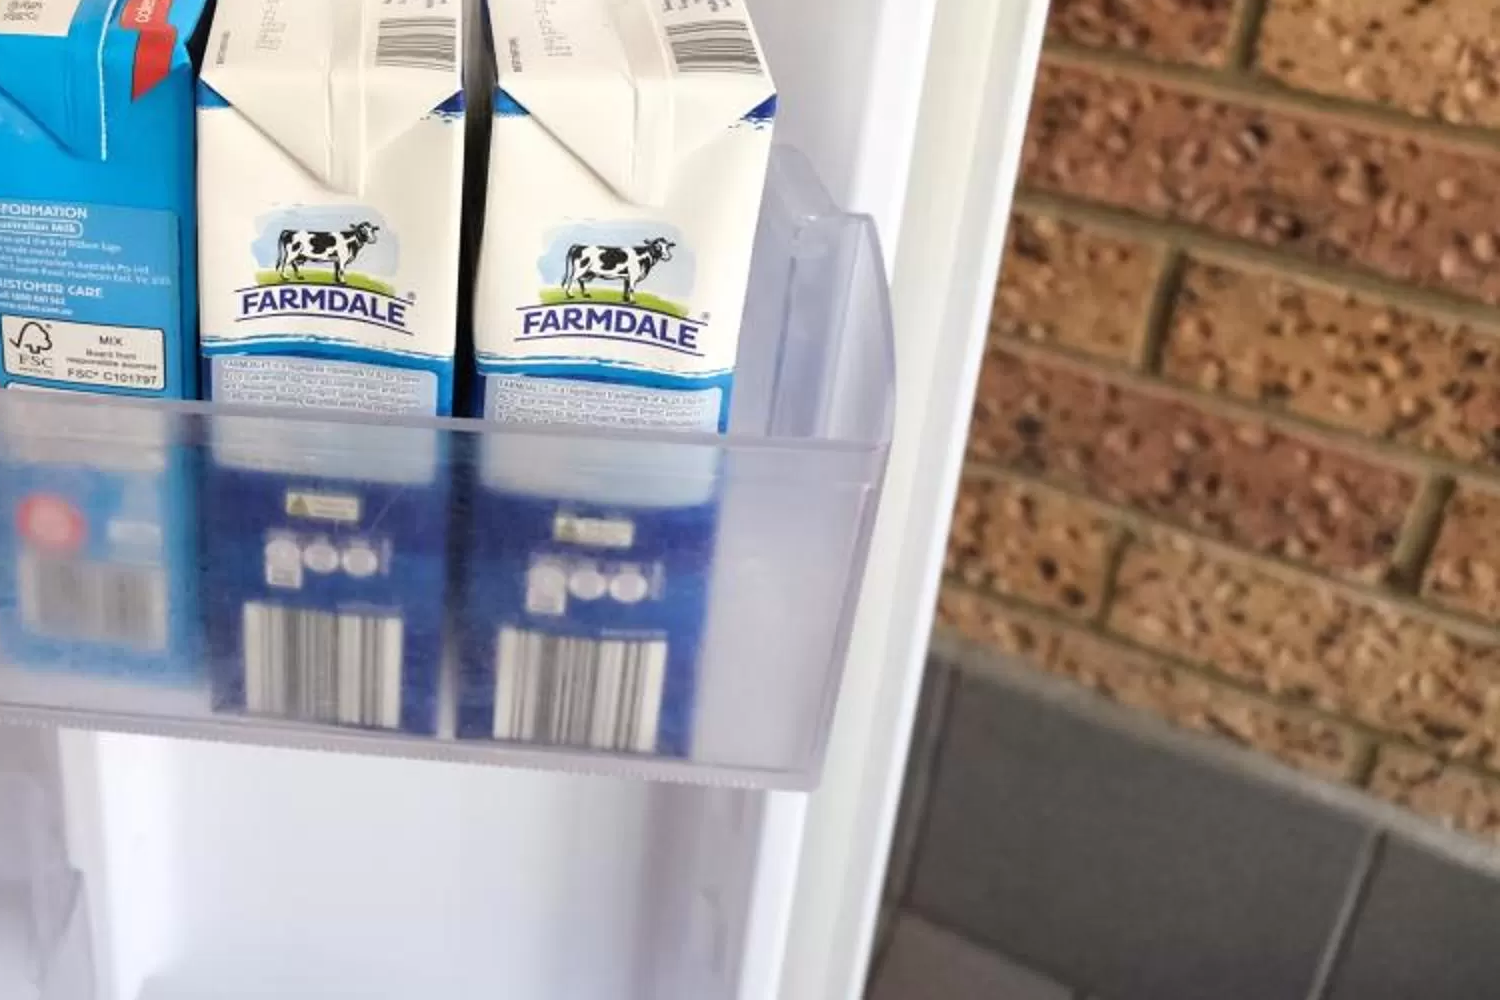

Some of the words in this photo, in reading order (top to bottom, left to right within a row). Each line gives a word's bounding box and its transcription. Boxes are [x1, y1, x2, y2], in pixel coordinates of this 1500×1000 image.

[51, 222, 77, 234] Milk
[67, 285, 104, 299] CARE
[242, 287, 407, 327] FARMDALE
[523, 307, 699, 350] FARMDALE
[99, 335, 124, 347] MIX
[19, 354, 54, 370] FSC
[103, 371, 158, 386] C101797
